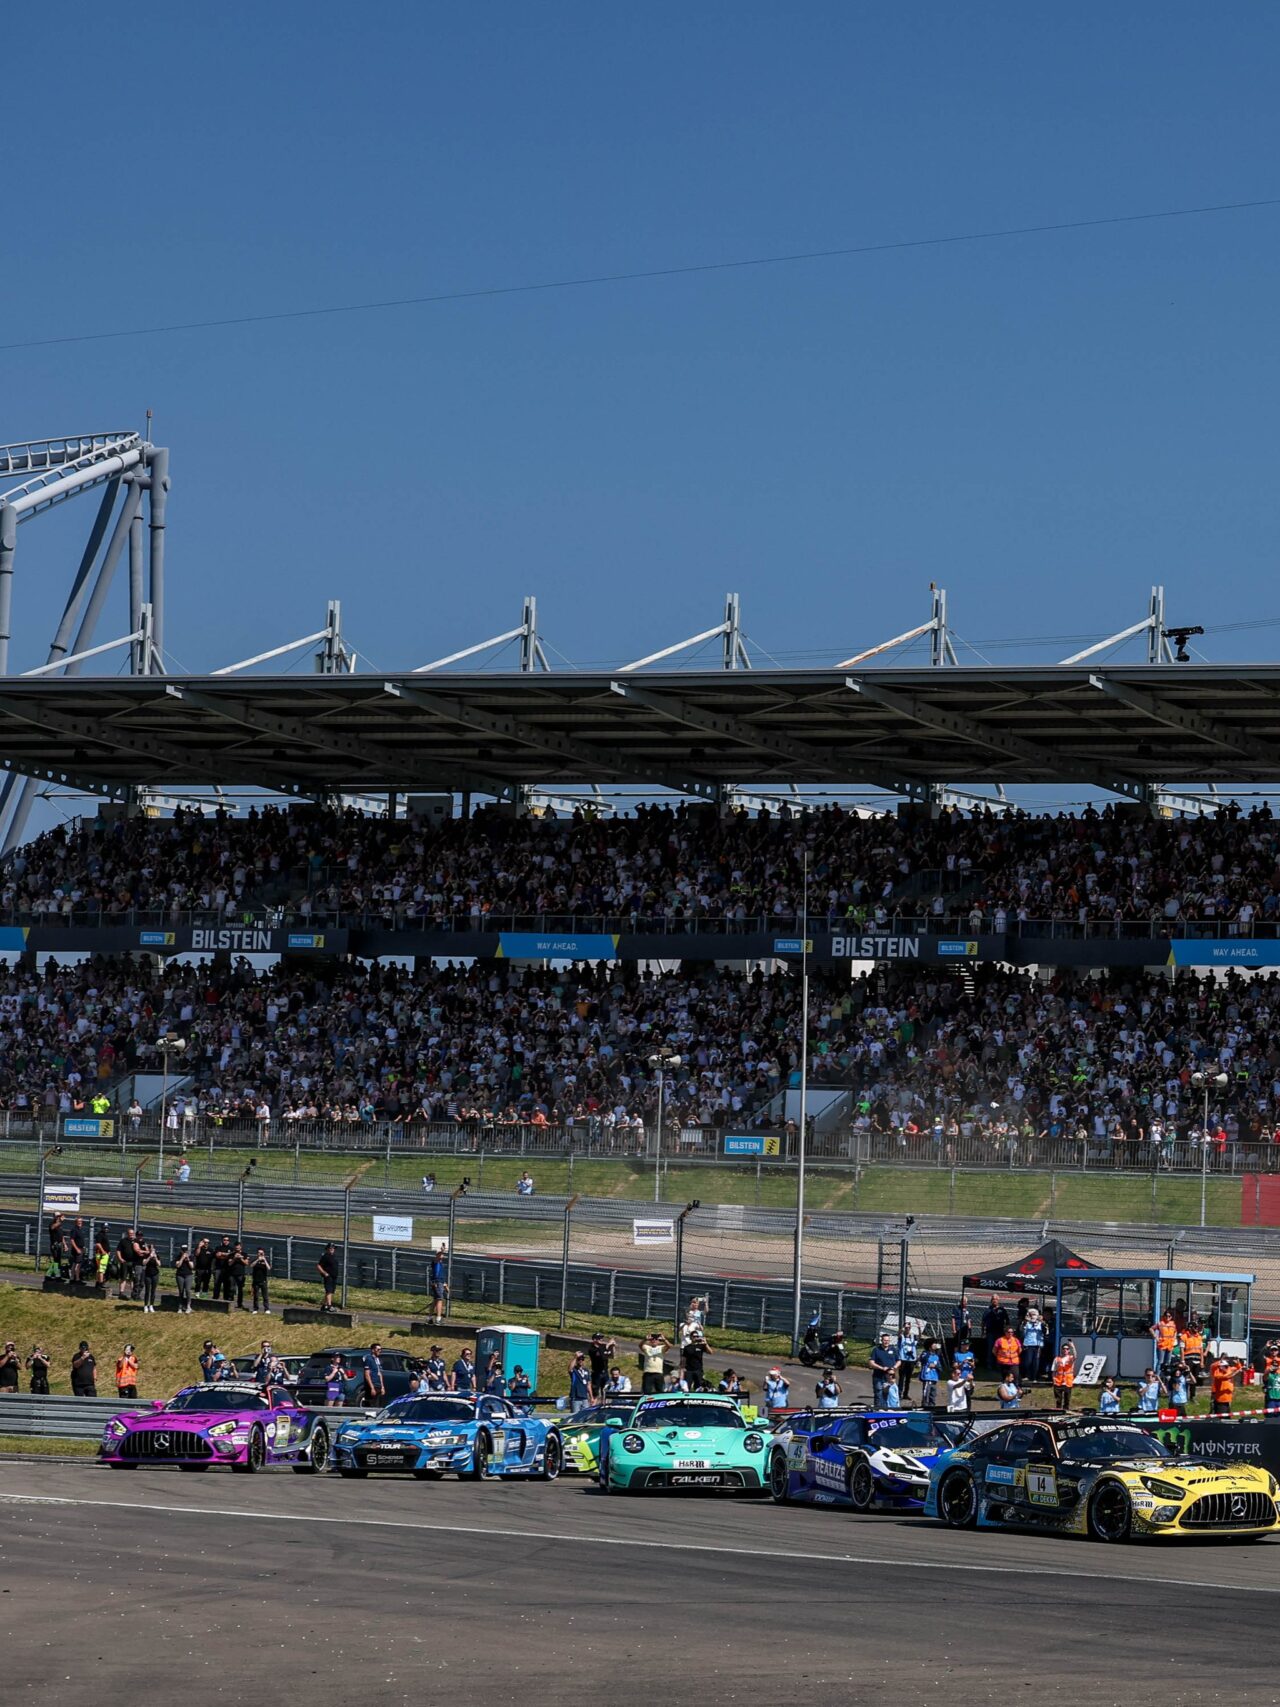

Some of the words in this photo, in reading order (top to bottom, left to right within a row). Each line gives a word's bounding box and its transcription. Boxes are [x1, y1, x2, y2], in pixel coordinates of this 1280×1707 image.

[191, 930, 272, 950] BILSTEIN
[536, 942, 551, 950] WAY
[552, 943, 578, 951] AHEAD.
[831, 937, 919, 958] BILSTEIN
[1213, 948, 1229, 956] WAY
[1230, 949, 1258, 957] AHEAD.
[68, 1124, 96, 1132] BILSTEIN
[729, 1141, 760, 1149] BILSTEIN
[979, 1279, 1008, 1289] 24MX
[1192, 1440, 1262, 1456] MONSTER
[815, 1457, 846, 1481] REALIZE
[671, 1475, 721, 1483] FALKEN
[989, 1469, 1013, 1480] BILSTEIN
[1037, 1477, 1046, 1492] 14
[1039, 1495, 1057, 1504] DEKRA
